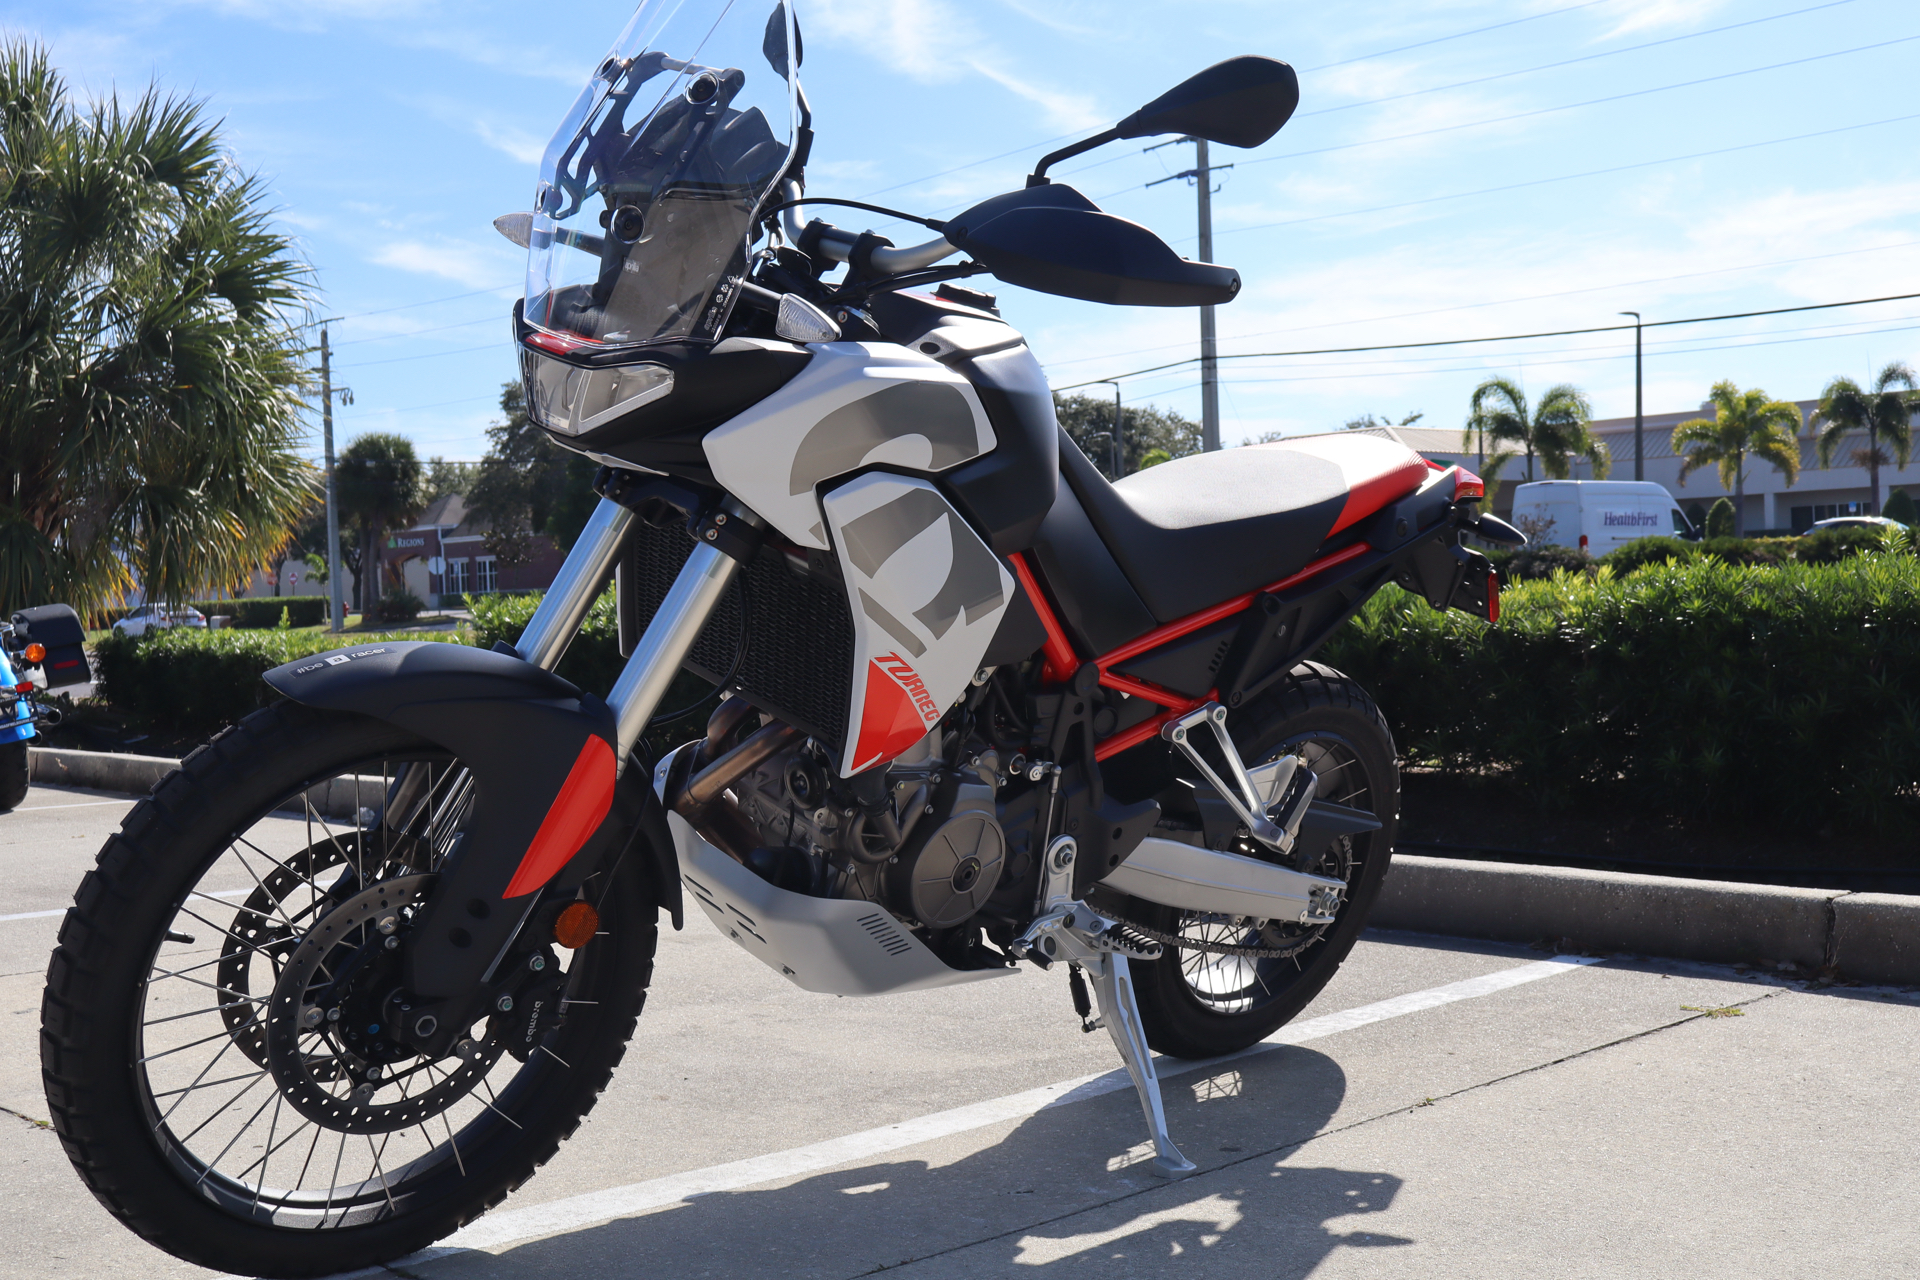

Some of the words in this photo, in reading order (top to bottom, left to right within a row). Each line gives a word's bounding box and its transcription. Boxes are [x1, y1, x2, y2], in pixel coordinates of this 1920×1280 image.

[1604, 511, 1658, 526] HealthFirst
[397, 537, 425, 548] REGIONS
[296, 662, 324, 674] #be
[350, 647, 386, 659] racer
[873, 650, 941, 722] TUAREG
[526, 1001, 543, 1042] brembo
